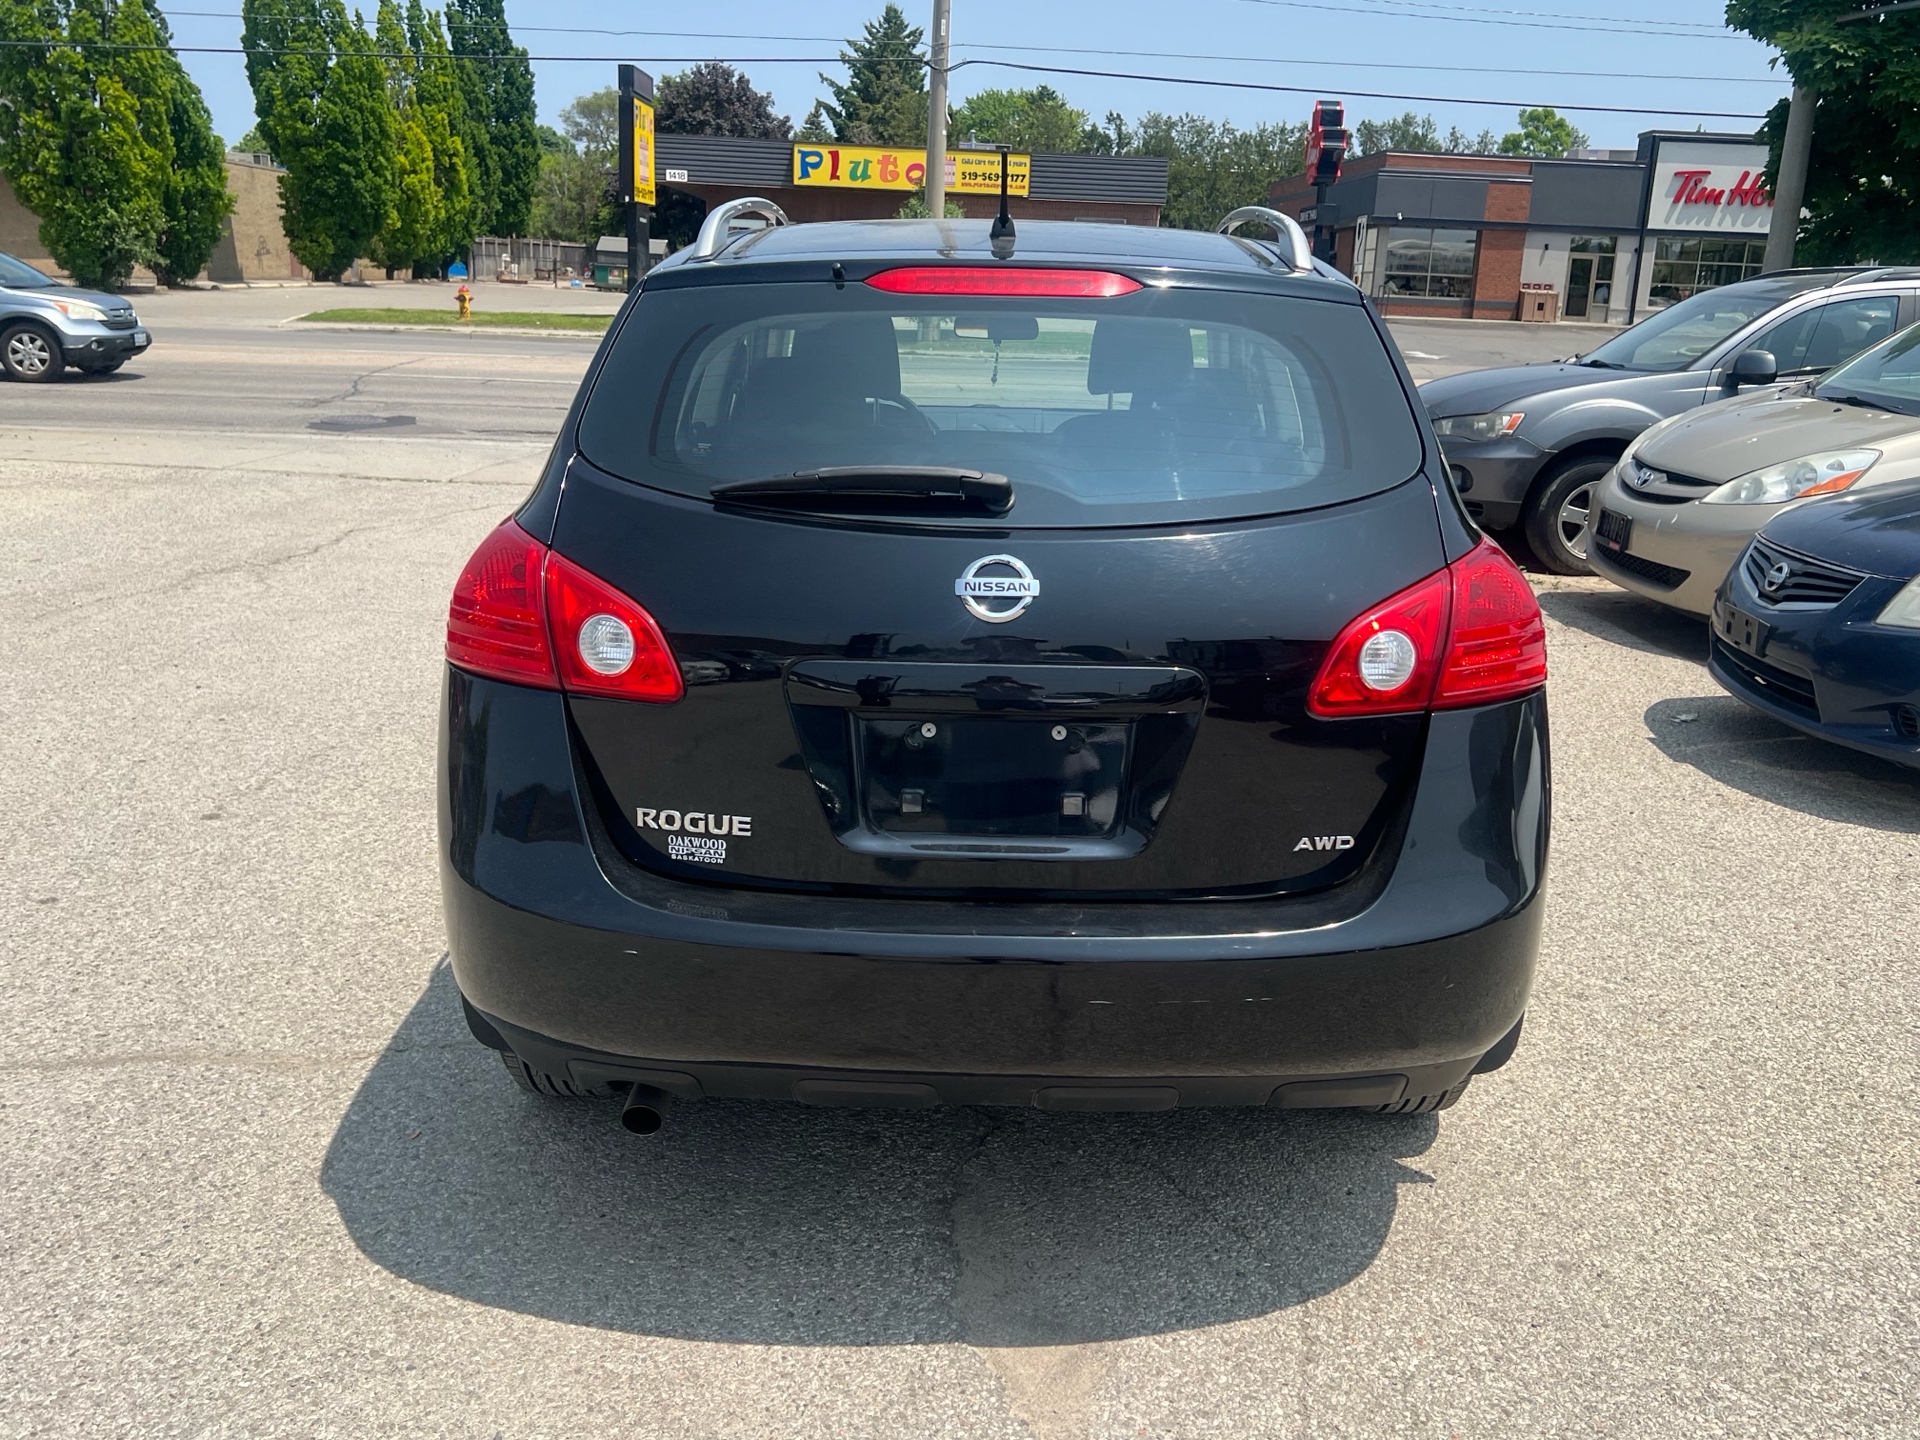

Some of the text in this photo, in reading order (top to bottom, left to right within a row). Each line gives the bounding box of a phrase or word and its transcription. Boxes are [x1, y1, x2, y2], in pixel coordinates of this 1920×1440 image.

[798, 149, 926, 184] Pluto
[668, 170, 687, 181] 1418
[1673, 171, 1726, 206] Tim
[964, 582, 1031, 592] NISSAN
[636, 808, 752, 836] ROGUE
[668, 835, 727, 849] OAKWOOD
[1292, 836, 1355, 852] AWD
[671, 854, 724, 864] SASKATOON
